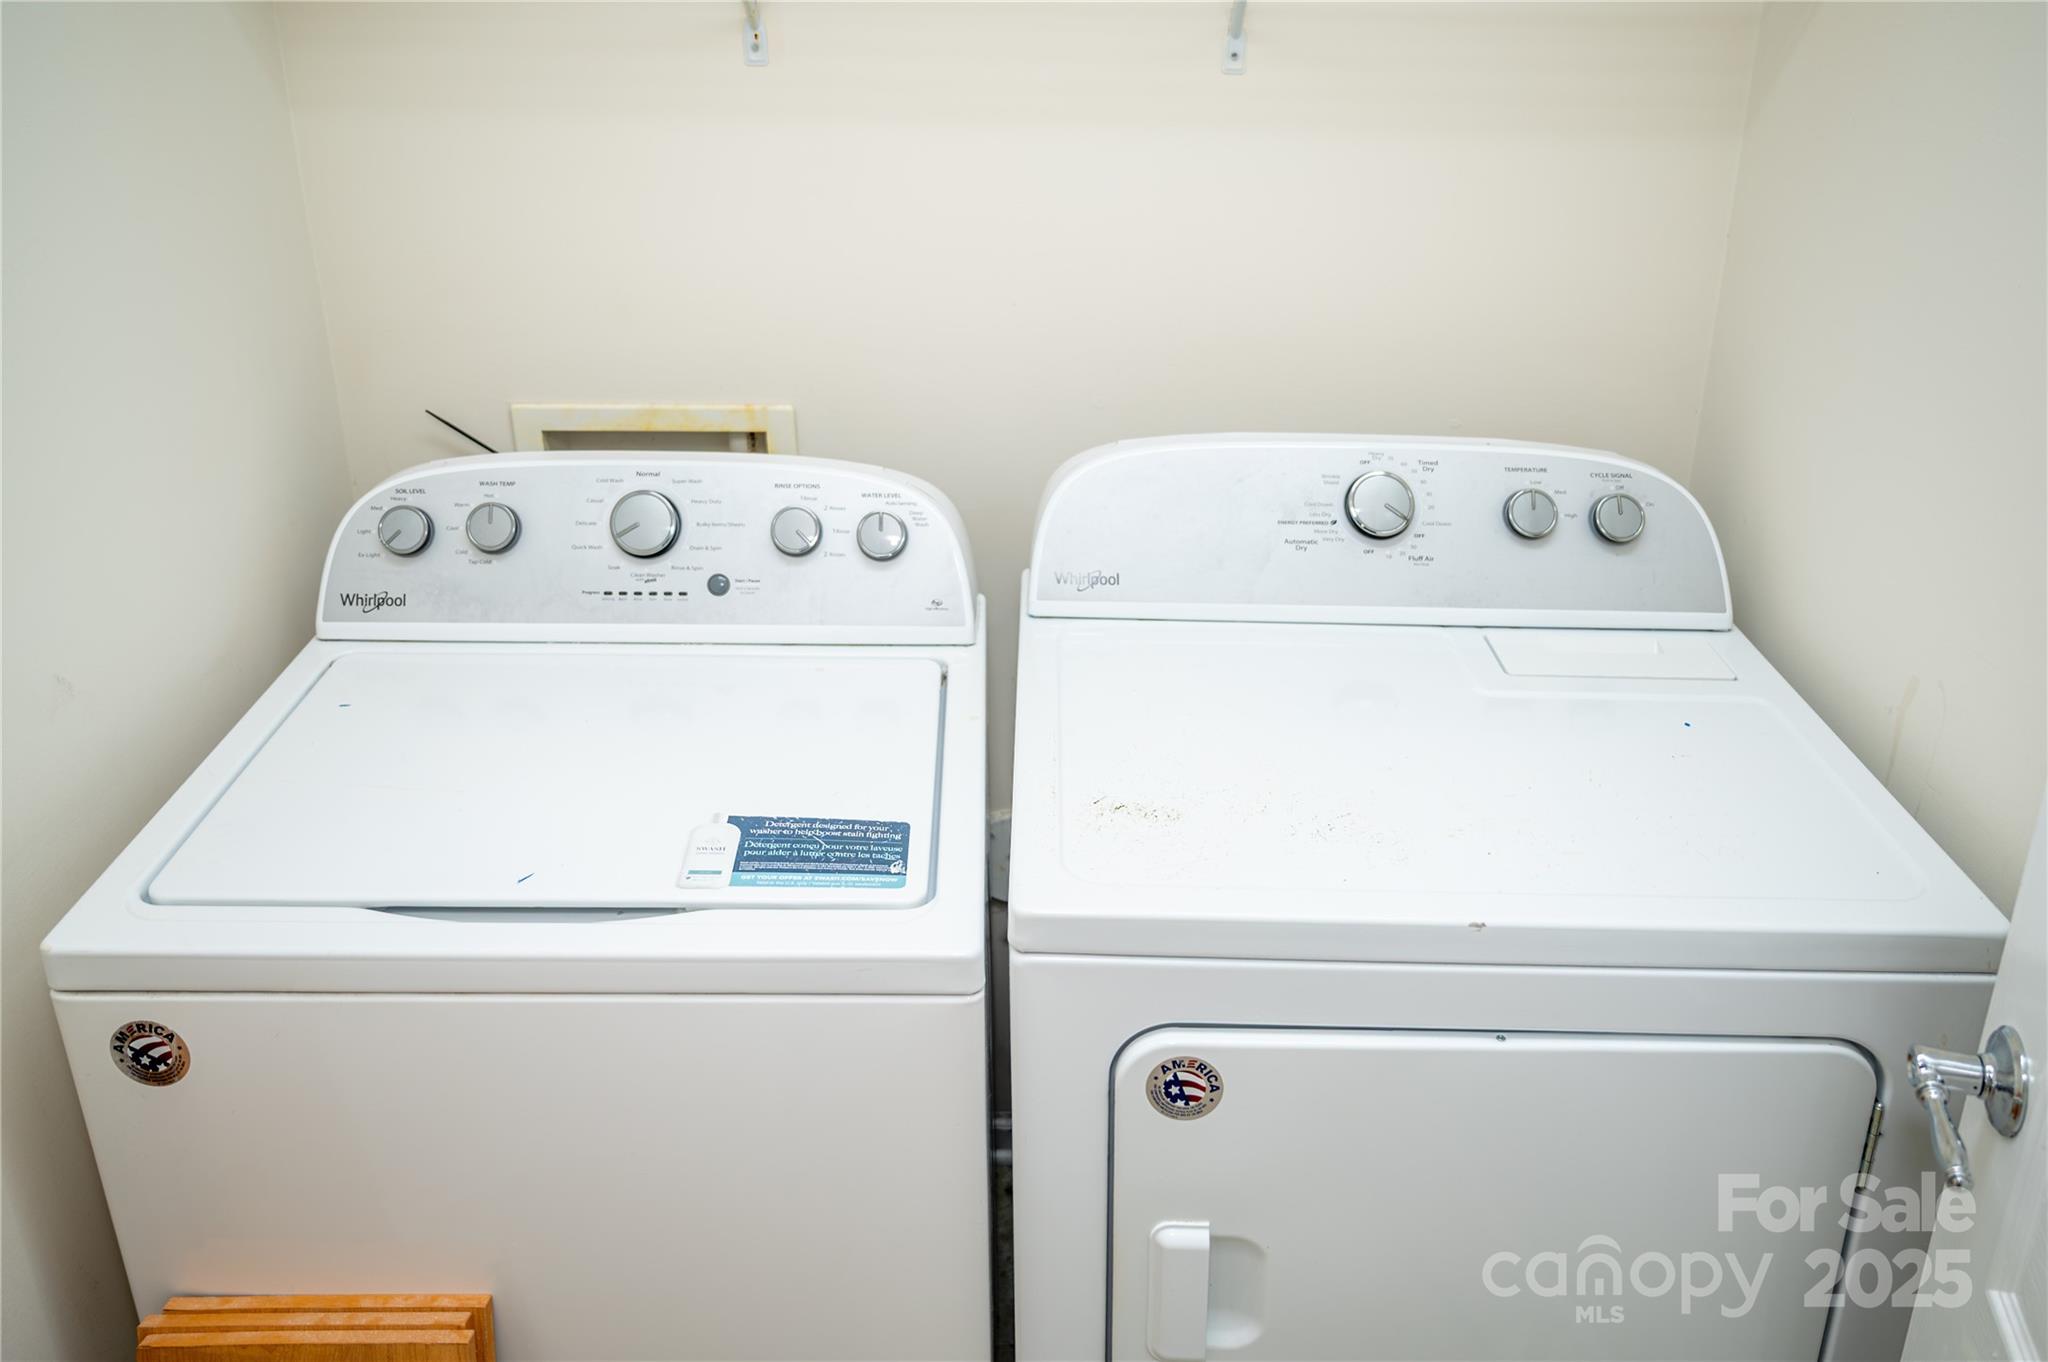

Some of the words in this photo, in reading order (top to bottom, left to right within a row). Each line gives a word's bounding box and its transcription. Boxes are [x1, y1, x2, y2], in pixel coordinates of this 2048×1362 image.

[1054, 570, 1120, 592] Whirlpool
[340, 591, 407, 613] Whirlpool
[765, 821, 811, 831] Detergent
[812, 821, 852, 832] designed
[868, 823, 889, 832] your
[795, 828, 814, 837] help
[815, 829, 841, 837] boost
[842, 830, 864, 838] stain
[866, 831, 902, 841] fighting
[743, 850, 767, 858] pour
[825, 850, 856, 858] contre
[822, 843, 843, 852] pour
[870, 844, 903, 852] laveuse
[113, 1024, 175, 1054] AMERICA
[1160, 1060, 1220, 1093] AMERICA
